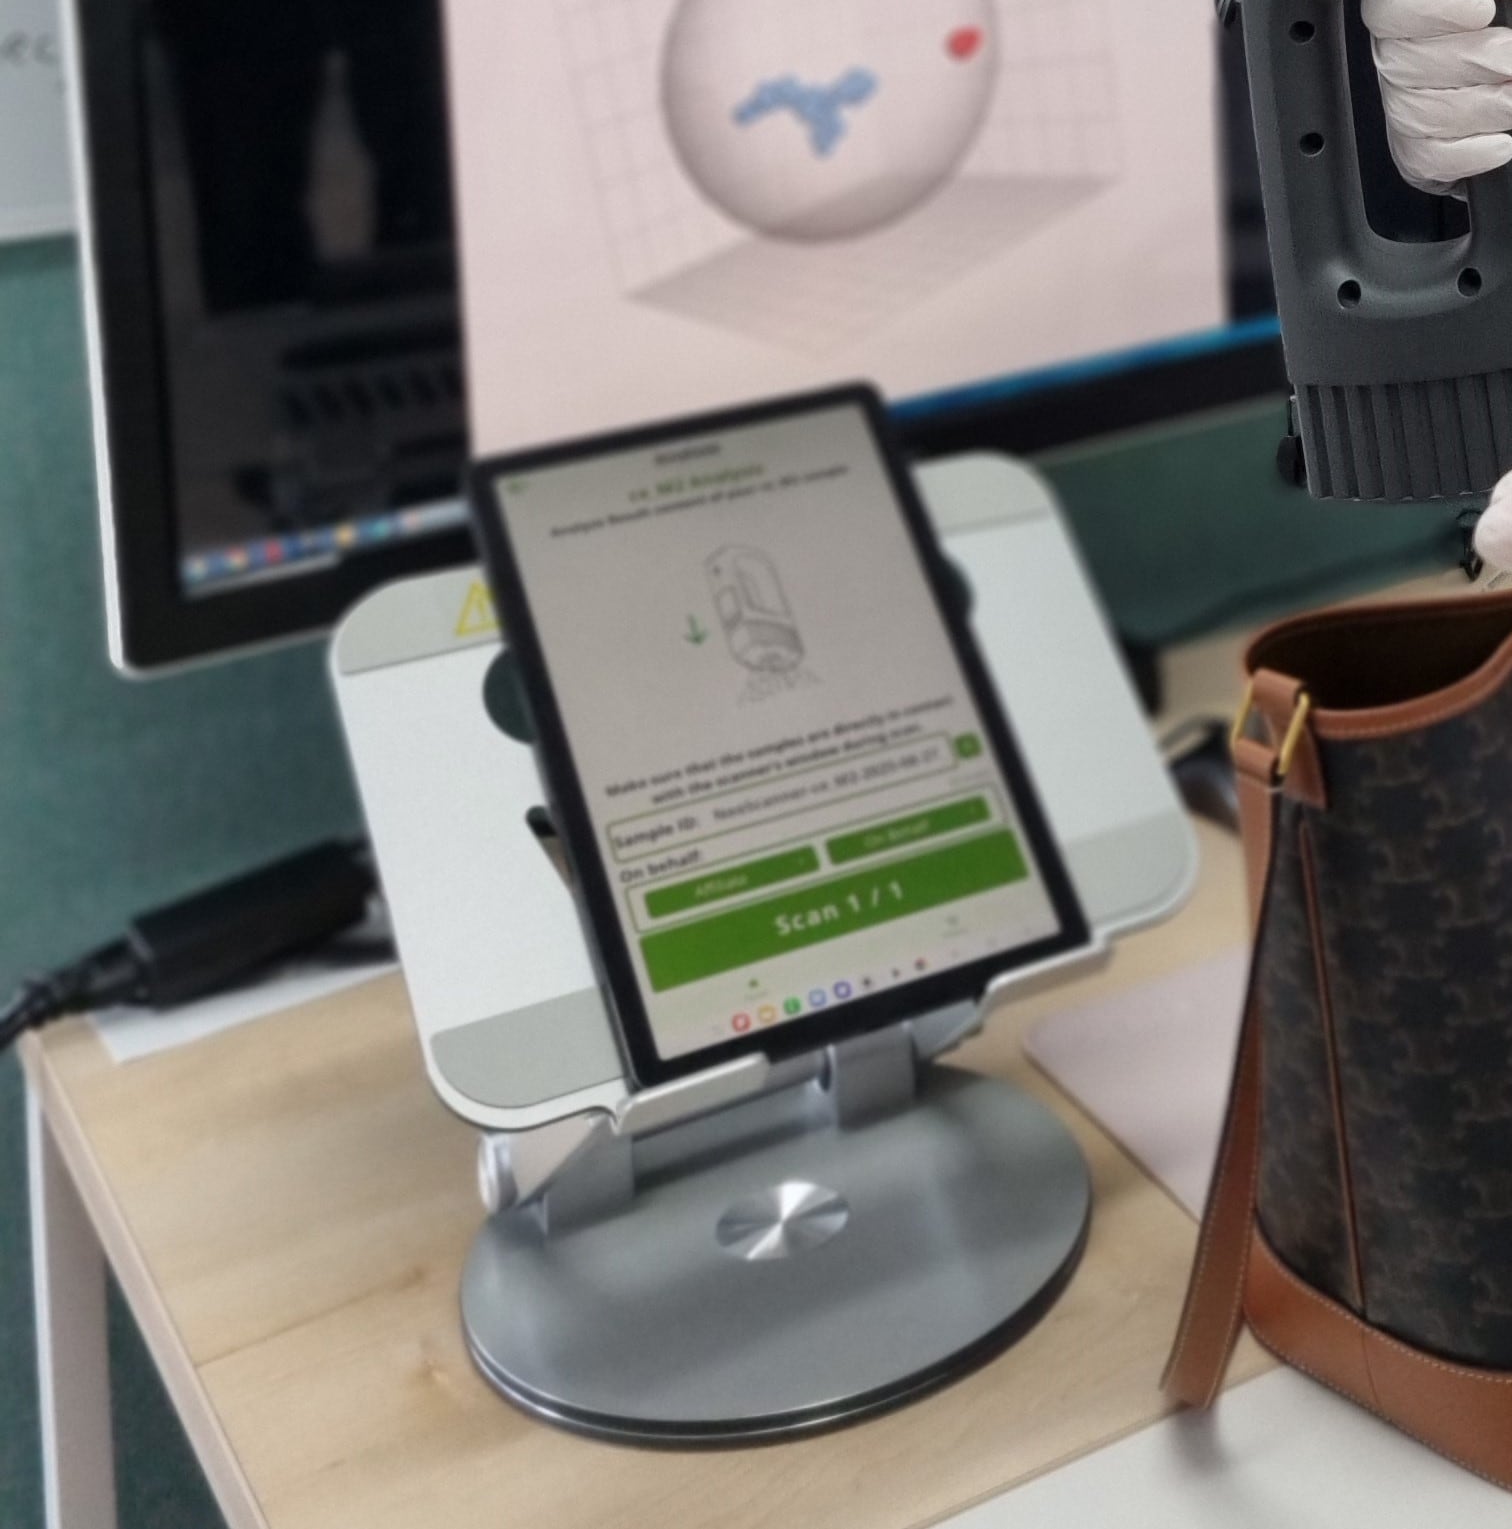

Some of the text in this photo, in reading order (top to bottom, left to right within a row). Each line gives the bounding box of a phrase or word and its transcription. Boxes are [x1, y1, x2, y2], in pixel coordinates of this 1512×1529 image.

[605, 777, 647, 798] Make
[650, 769, 682, 786] sure
[685, 756, 716, 775] that
[719, 750, 744, 767] the
[747, 734, 804, 759] samples
[807, 727, 830, 743] are
[833, 712, 885, 736] directly
[652, 784, 685, 805] with
[688, 777, 713, 794] the
[785, 743, 840, 768] window
[614, 821, 674, 849] Sample
[619, 866, 645, 885] On
[774, 878, 904, 936] Scan 1 / 1
